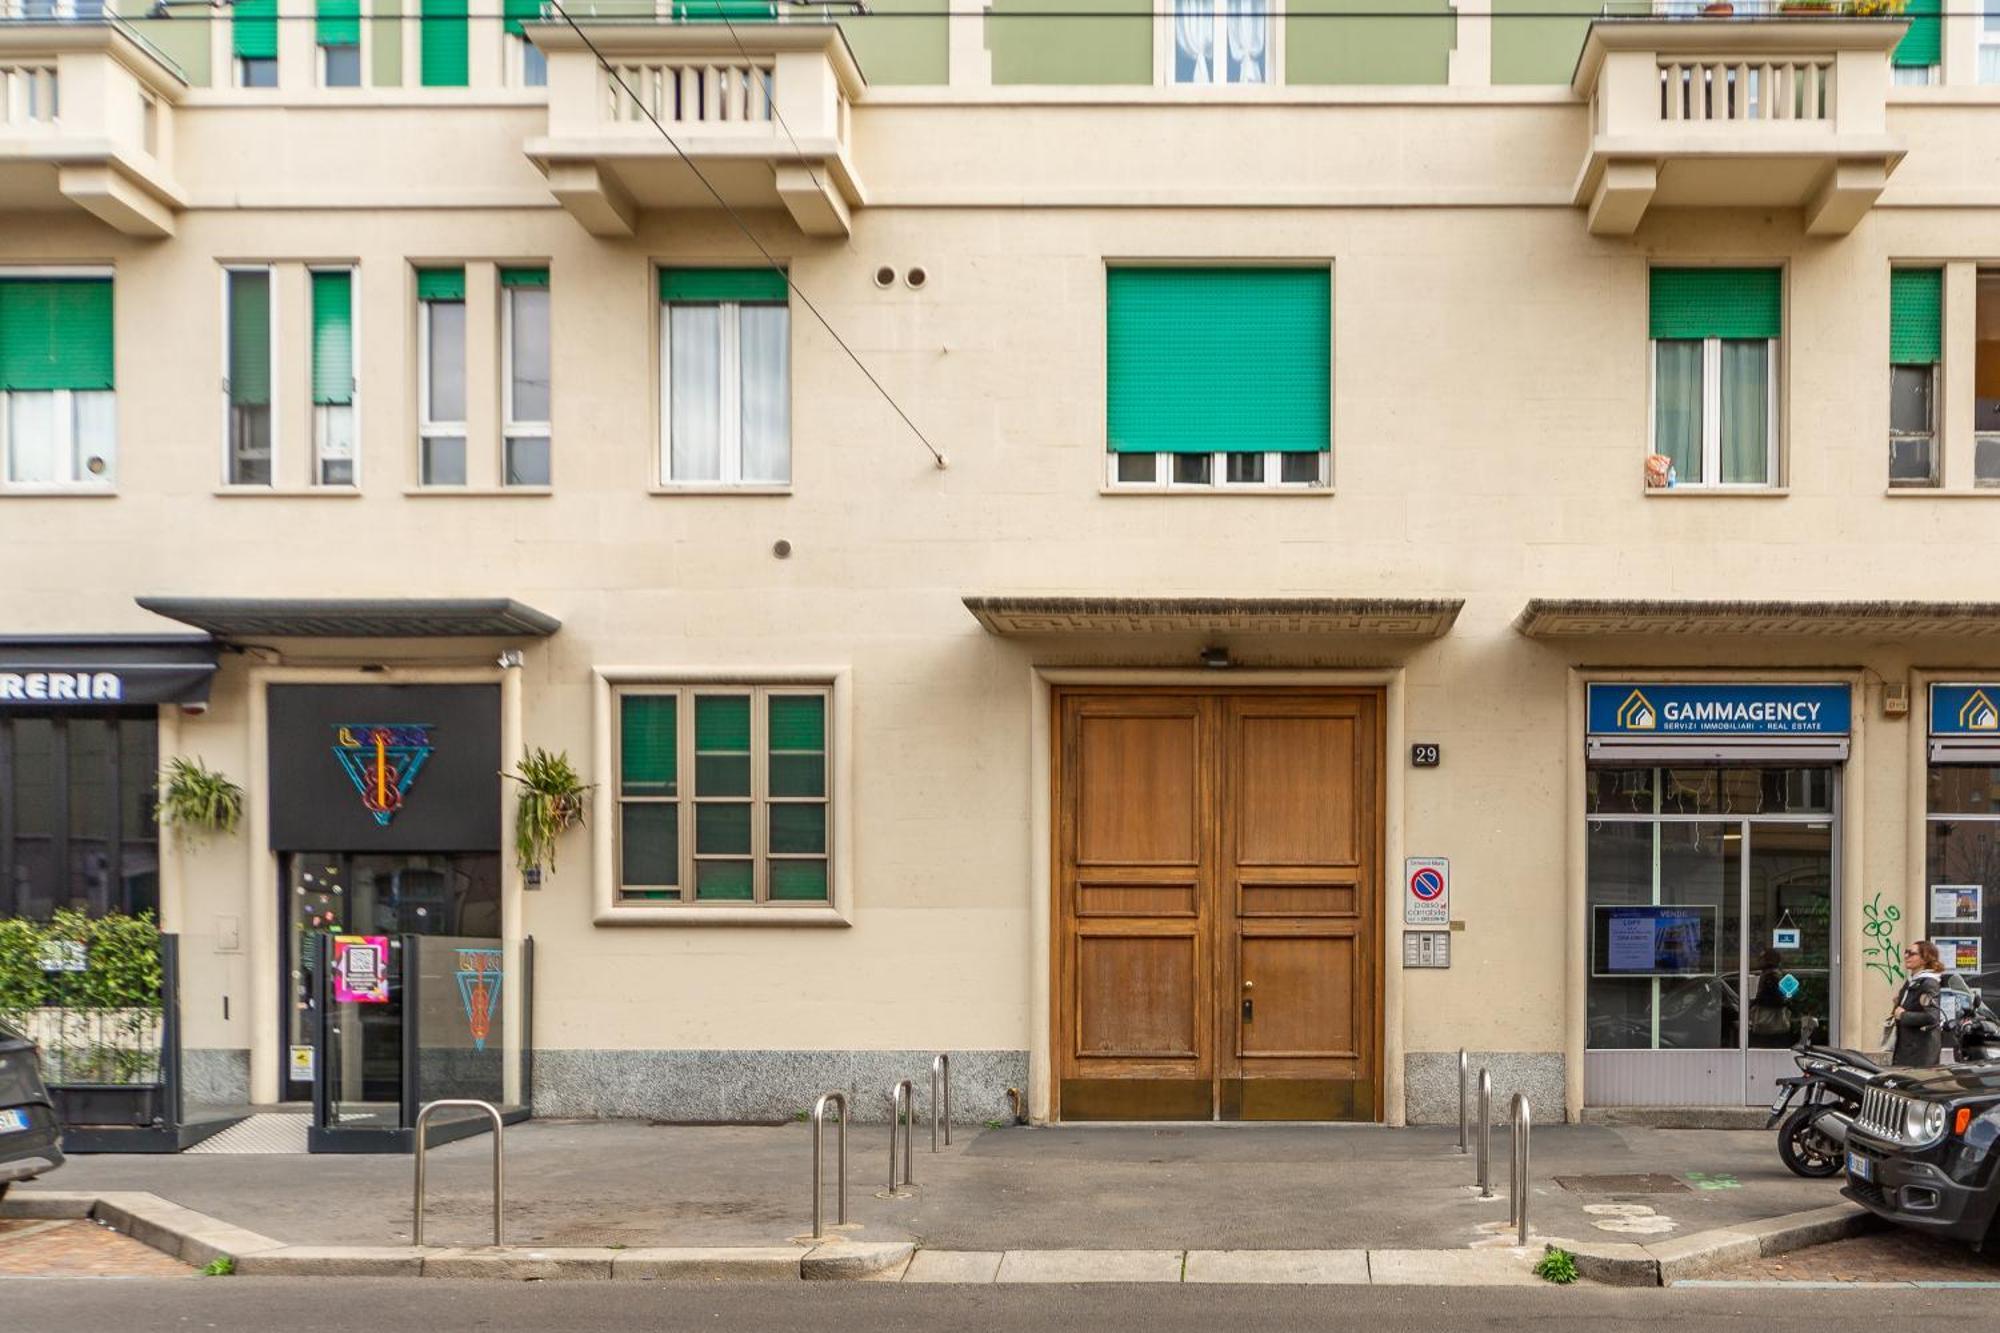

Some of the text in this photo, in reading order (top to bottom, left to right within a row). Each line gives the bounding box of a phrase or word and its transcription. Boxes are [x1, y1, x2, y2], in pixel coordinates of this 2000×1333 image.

[0, 672, 121, 700] RERIA
[1663, 702, 1821, 721] GAMMAGENCY
[1663, 722, 1697, 730] SERVIZI
[1701, 722, 1754, 730] IMMOBILIARI
[1767, 722, 1788, 730] REAL
[1791, 722, 1821, 730] ESTATE
[1416, 747, 1436, 762] 29
